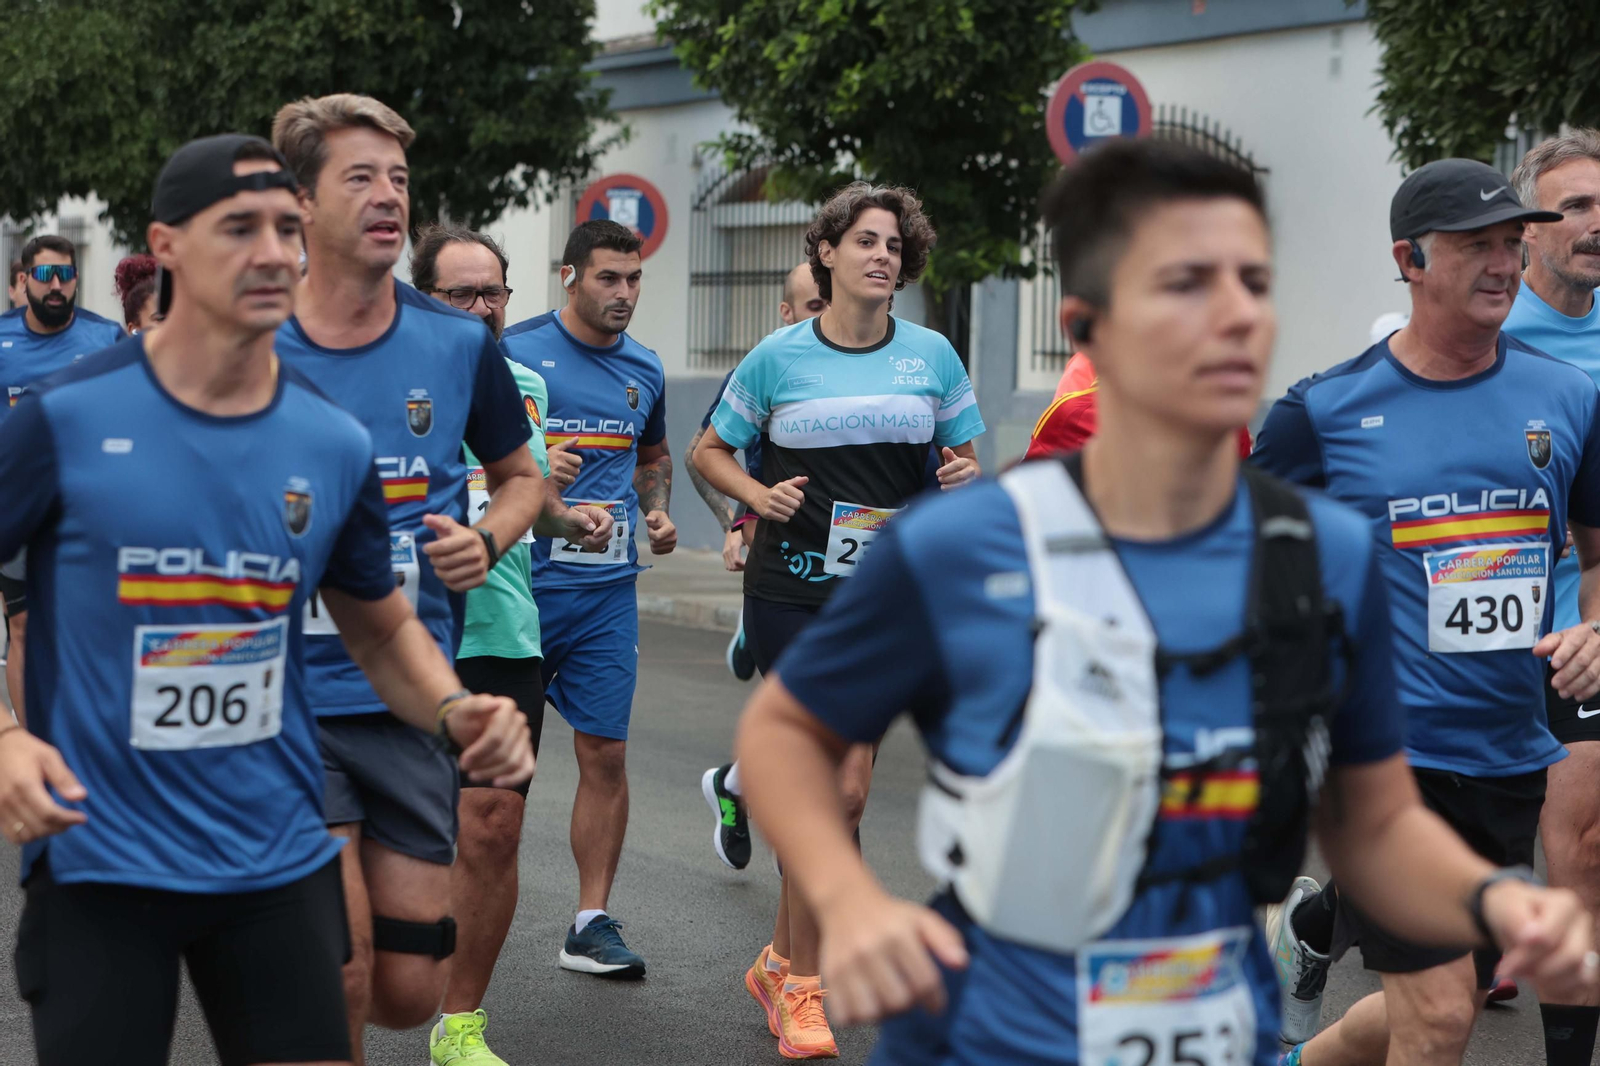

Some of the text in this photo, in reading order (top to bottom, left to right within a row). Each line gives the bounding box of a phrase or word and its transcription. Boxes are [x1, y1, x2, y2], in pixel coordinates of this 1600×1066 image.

[891, 375, 930, 386] JEREZ
[779, 411, 935, 434] NATACIÓN MÁSTE
[841, 510, 883, 523] CARRERA
[1437, 553, 1540, 570] CARRERA POPULAR
[1496, 568, 1521, 577] SANTO
[1523, 566, 1545, 575] ANGEL
[1444, 593, 1524, 635] 430
[154, 683, 248, 727] 206
